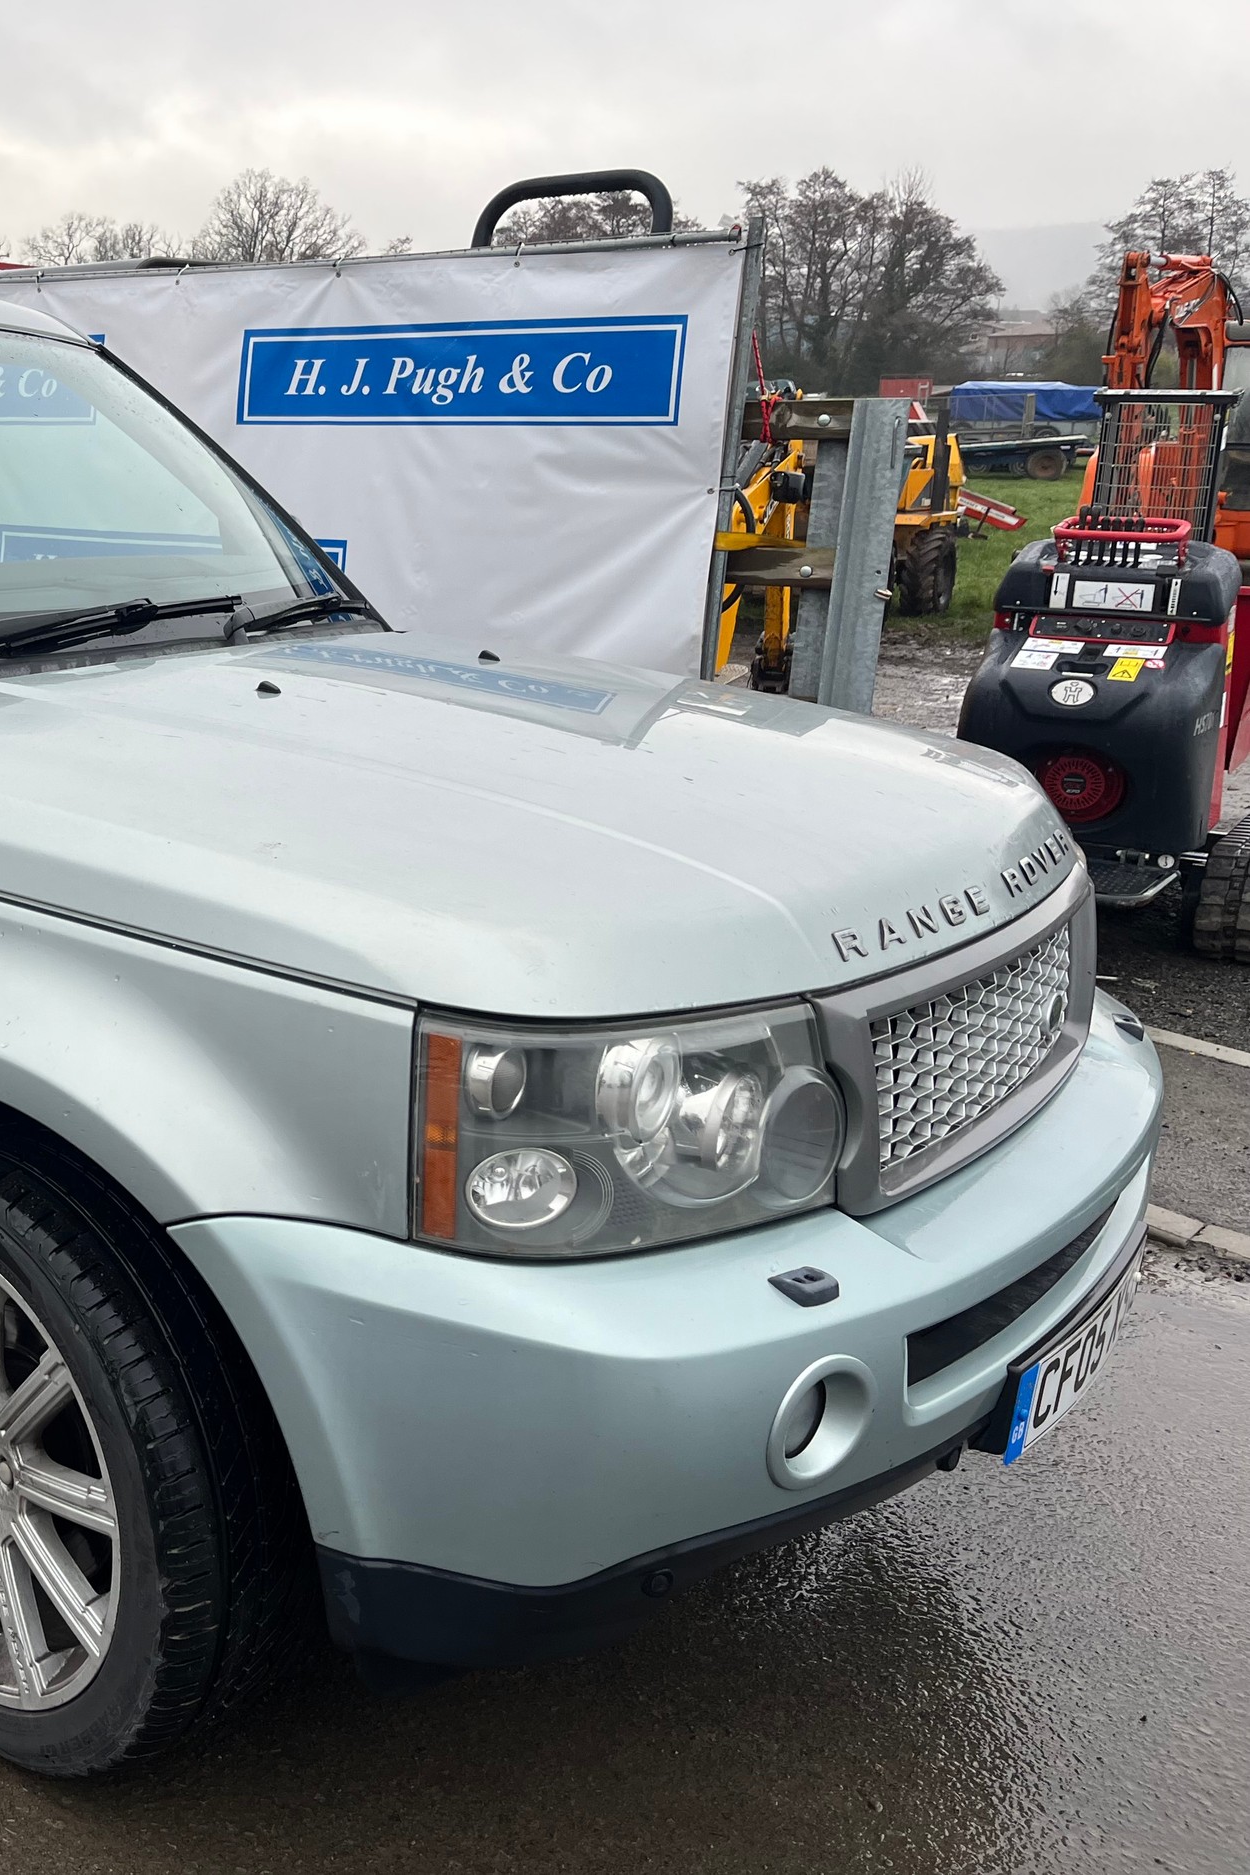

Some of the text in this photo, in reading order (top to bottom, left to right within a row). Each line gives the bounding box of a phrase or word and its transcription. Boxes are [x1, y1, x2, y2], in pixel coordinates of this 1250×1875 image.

[18, 368, 58, 398] Co
[283, 351, 613, 405] H. J. Pugh & Co
[831, 828, 1070, 962] RANGE ROVER
[1033, 1304, 1113, 1429] CF05
[1011, 1421, 1026, 1445] GB
